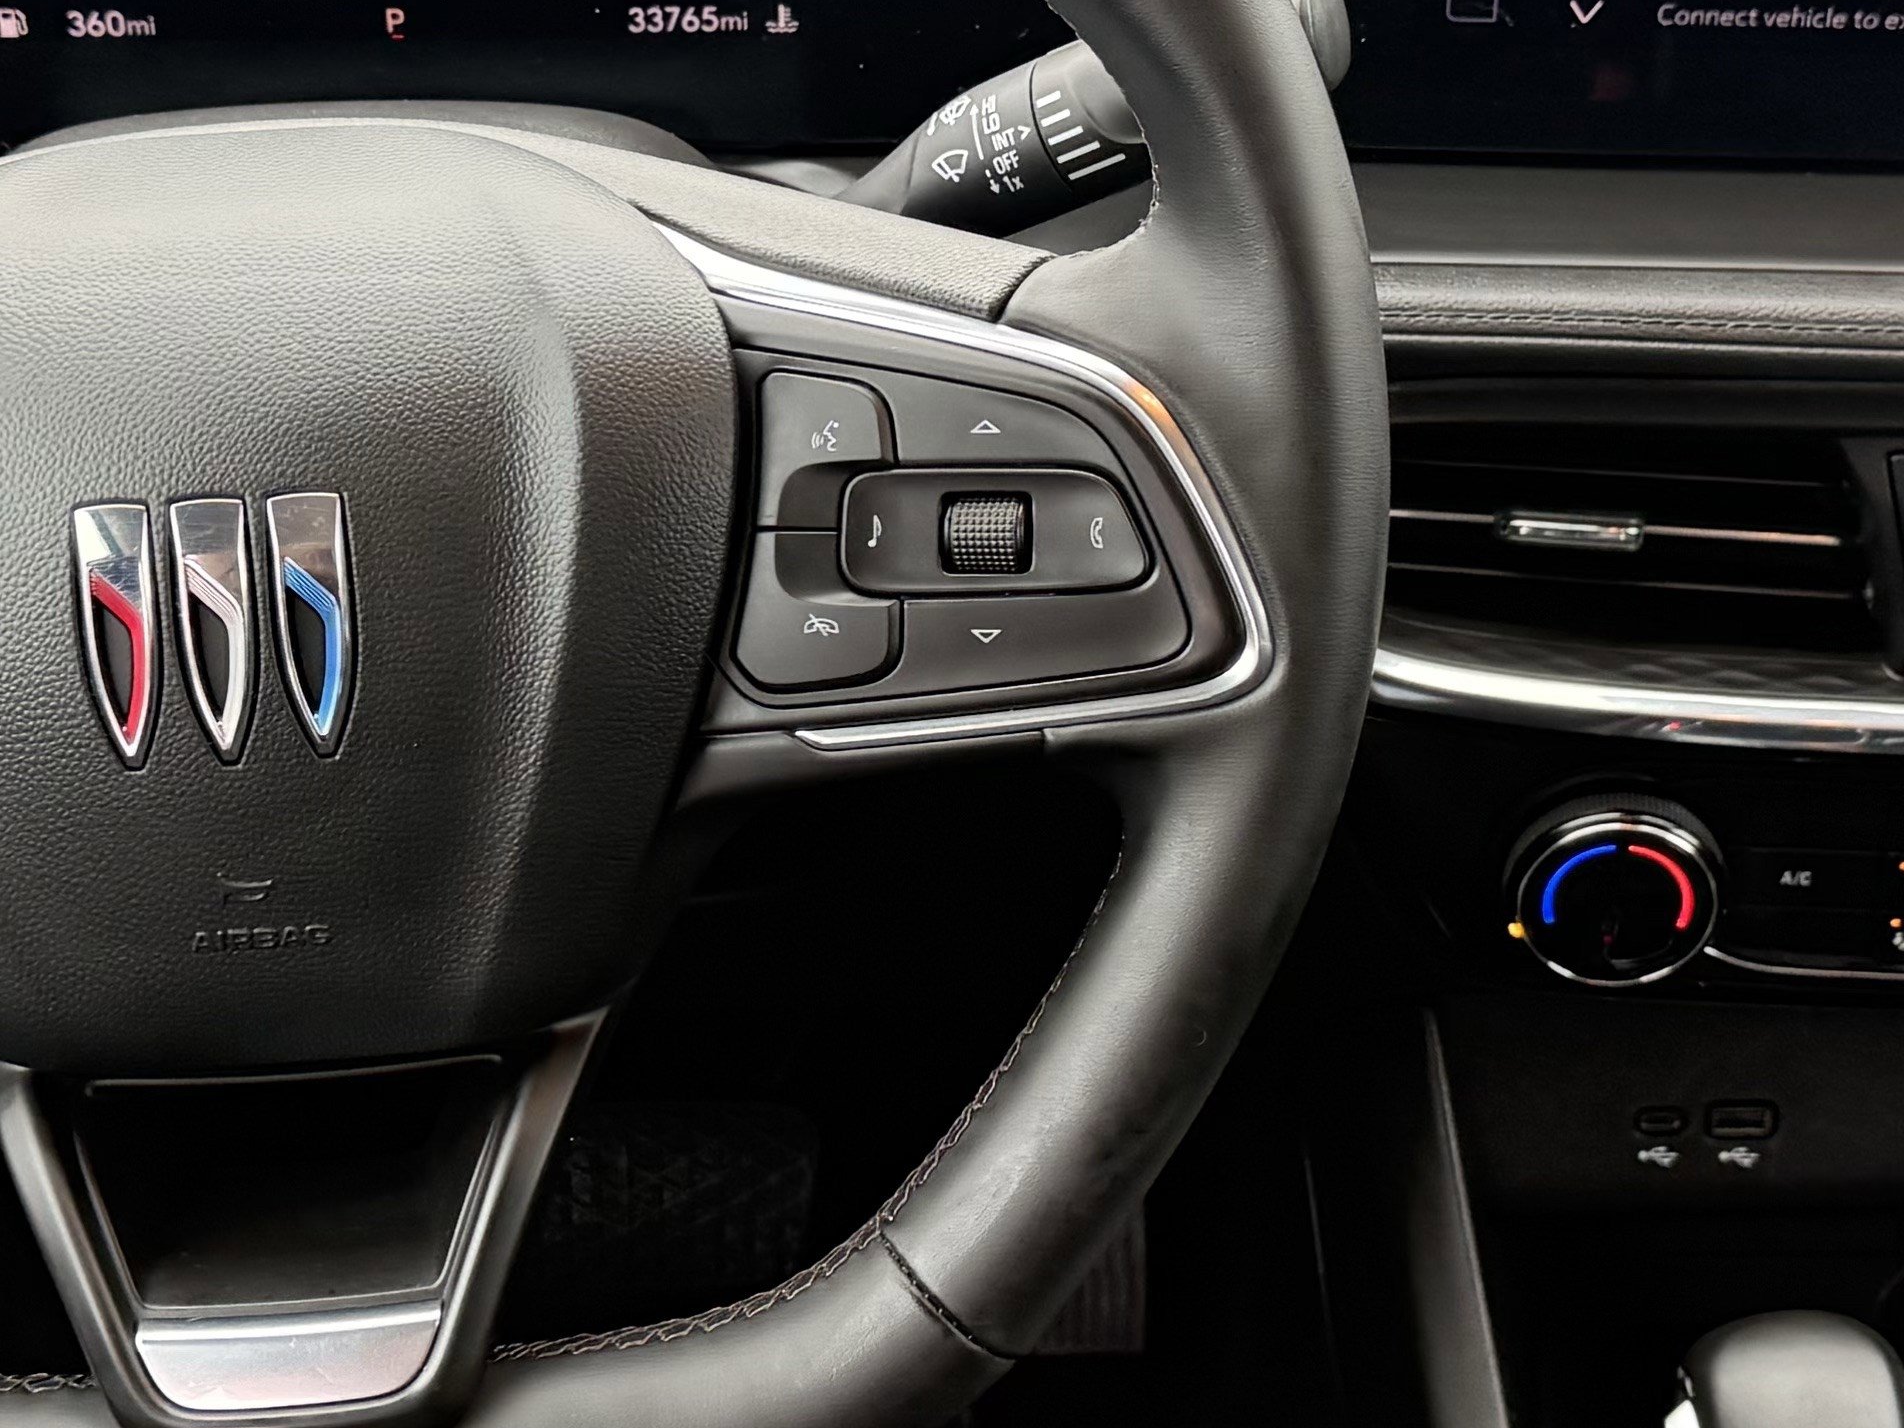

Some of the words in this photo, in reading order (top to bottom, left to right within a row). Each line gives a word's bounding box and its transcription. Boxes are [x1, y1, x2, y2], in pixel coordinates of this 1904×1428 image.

[385, 7, 405, 34] P
[1656, 3, 1759, 27] Connect
[1763, 6, 1848, 30] vehicle
[1853, 10, 1880, 30] to
[982, 95, 996, 116] HI
[982, 112, 1000, 134] LO
[992, 128, 1016, 151] INT
[992, 150, 1019, 174] OFF
[1002, 176, 1024, 192] 1x
[1779, 870, 1812, 886] A/C
[191, 925, 332, 954] AIRBAG
